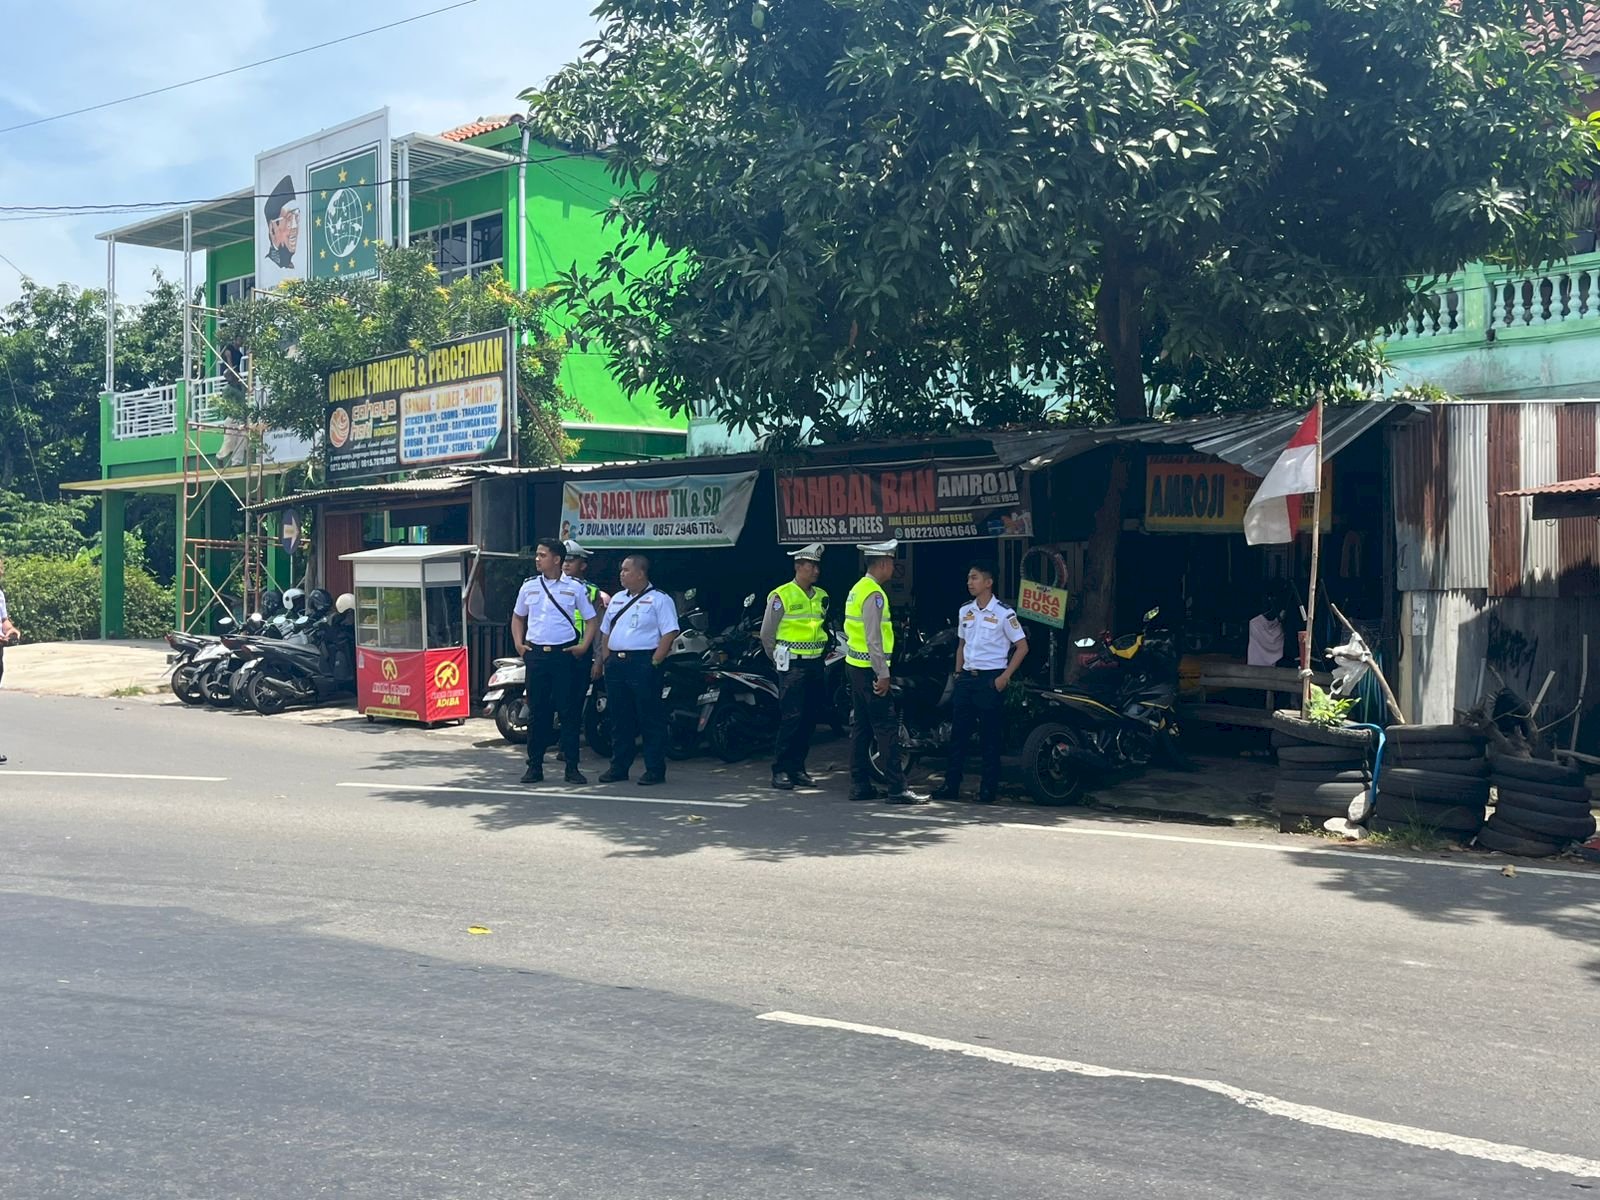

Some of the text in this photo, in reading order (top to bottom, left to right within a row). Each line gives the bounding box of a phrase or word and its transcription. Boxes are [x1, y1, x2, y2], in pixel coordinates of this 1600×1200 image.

[329, 336, 503, 402] DIGITAL PRINTING & PERCETAKAN
[779, 468, 1018, 517] TAMBAL BAN AMROJI
[1149, 473, 1225, 518] AMROJI
[578, 486, 723, 520] LES BACA KILAT TK & SD
[578, 522, 646, 537] 3 BULAN BISA BACA
[653, 523, 674, 537] 0857
[675, 522, 698, 536] 2946
[786, 515, 884, 536] TUBELESS & PREES
[904, 524, 978, 539] 082220064646
[1023, 588, 1060, 608] BUKA
[1022, 599, 1060, 618] BOSS
